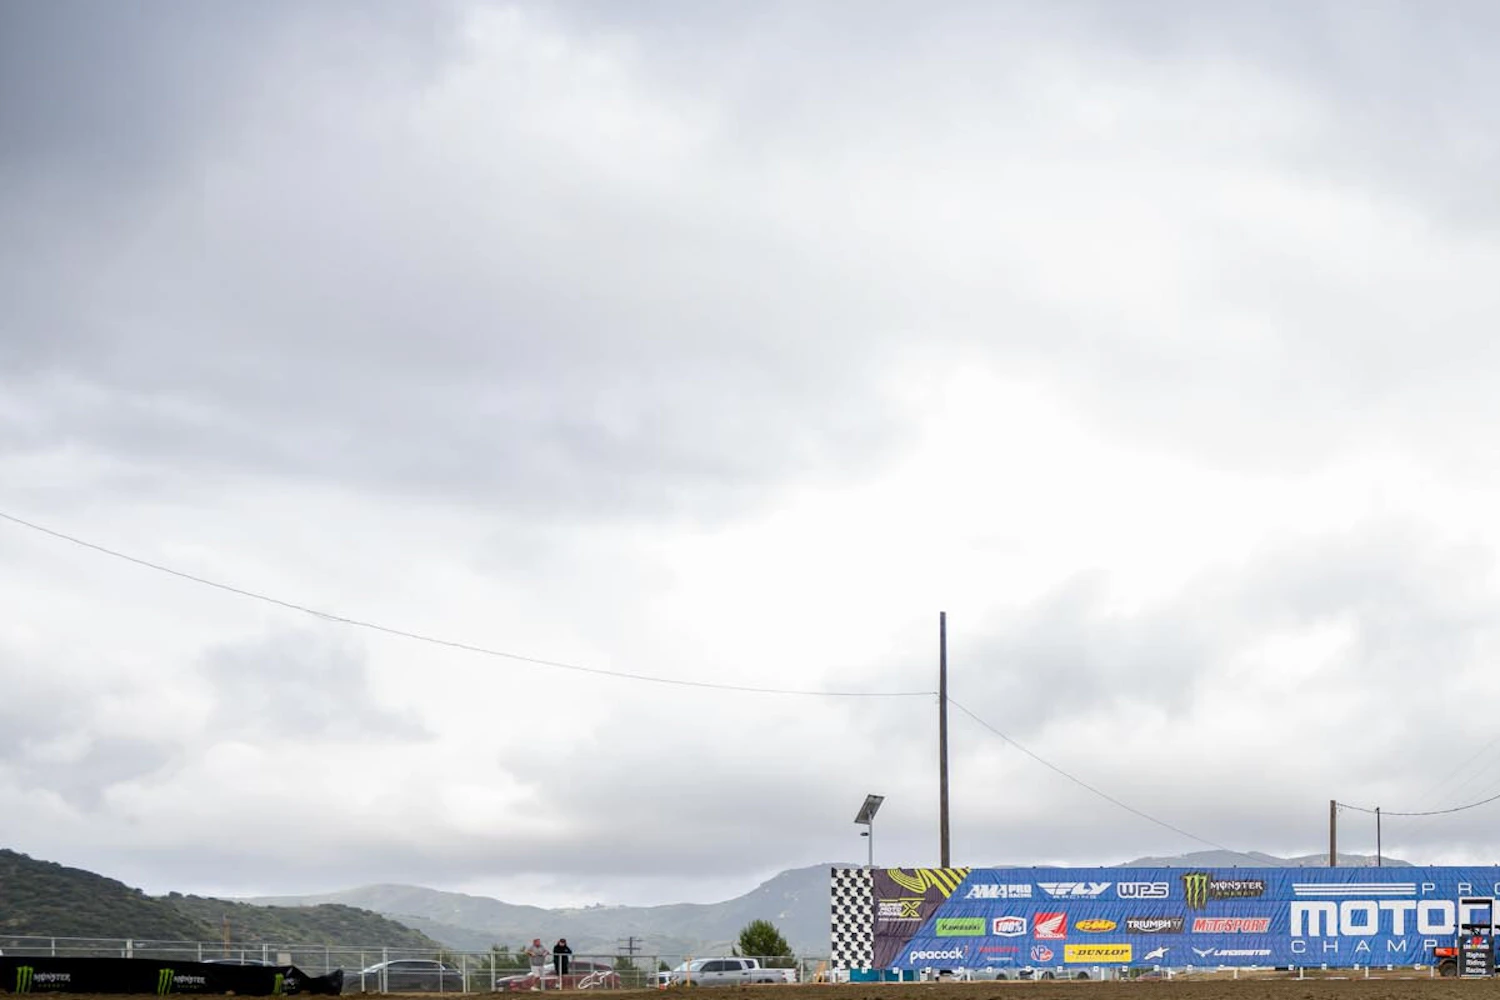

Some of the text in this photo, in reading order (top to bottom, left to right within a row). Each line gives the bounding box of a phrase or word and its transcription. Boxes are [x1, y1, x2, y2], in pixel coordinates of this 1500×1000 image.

[1118, 883, 1168, 897] WPS
[1210, 881, 1263, 891] MONSTER
[1127, 920, 1171, 931] TRIUMPH
[910, 947, 963, 964] peacock
